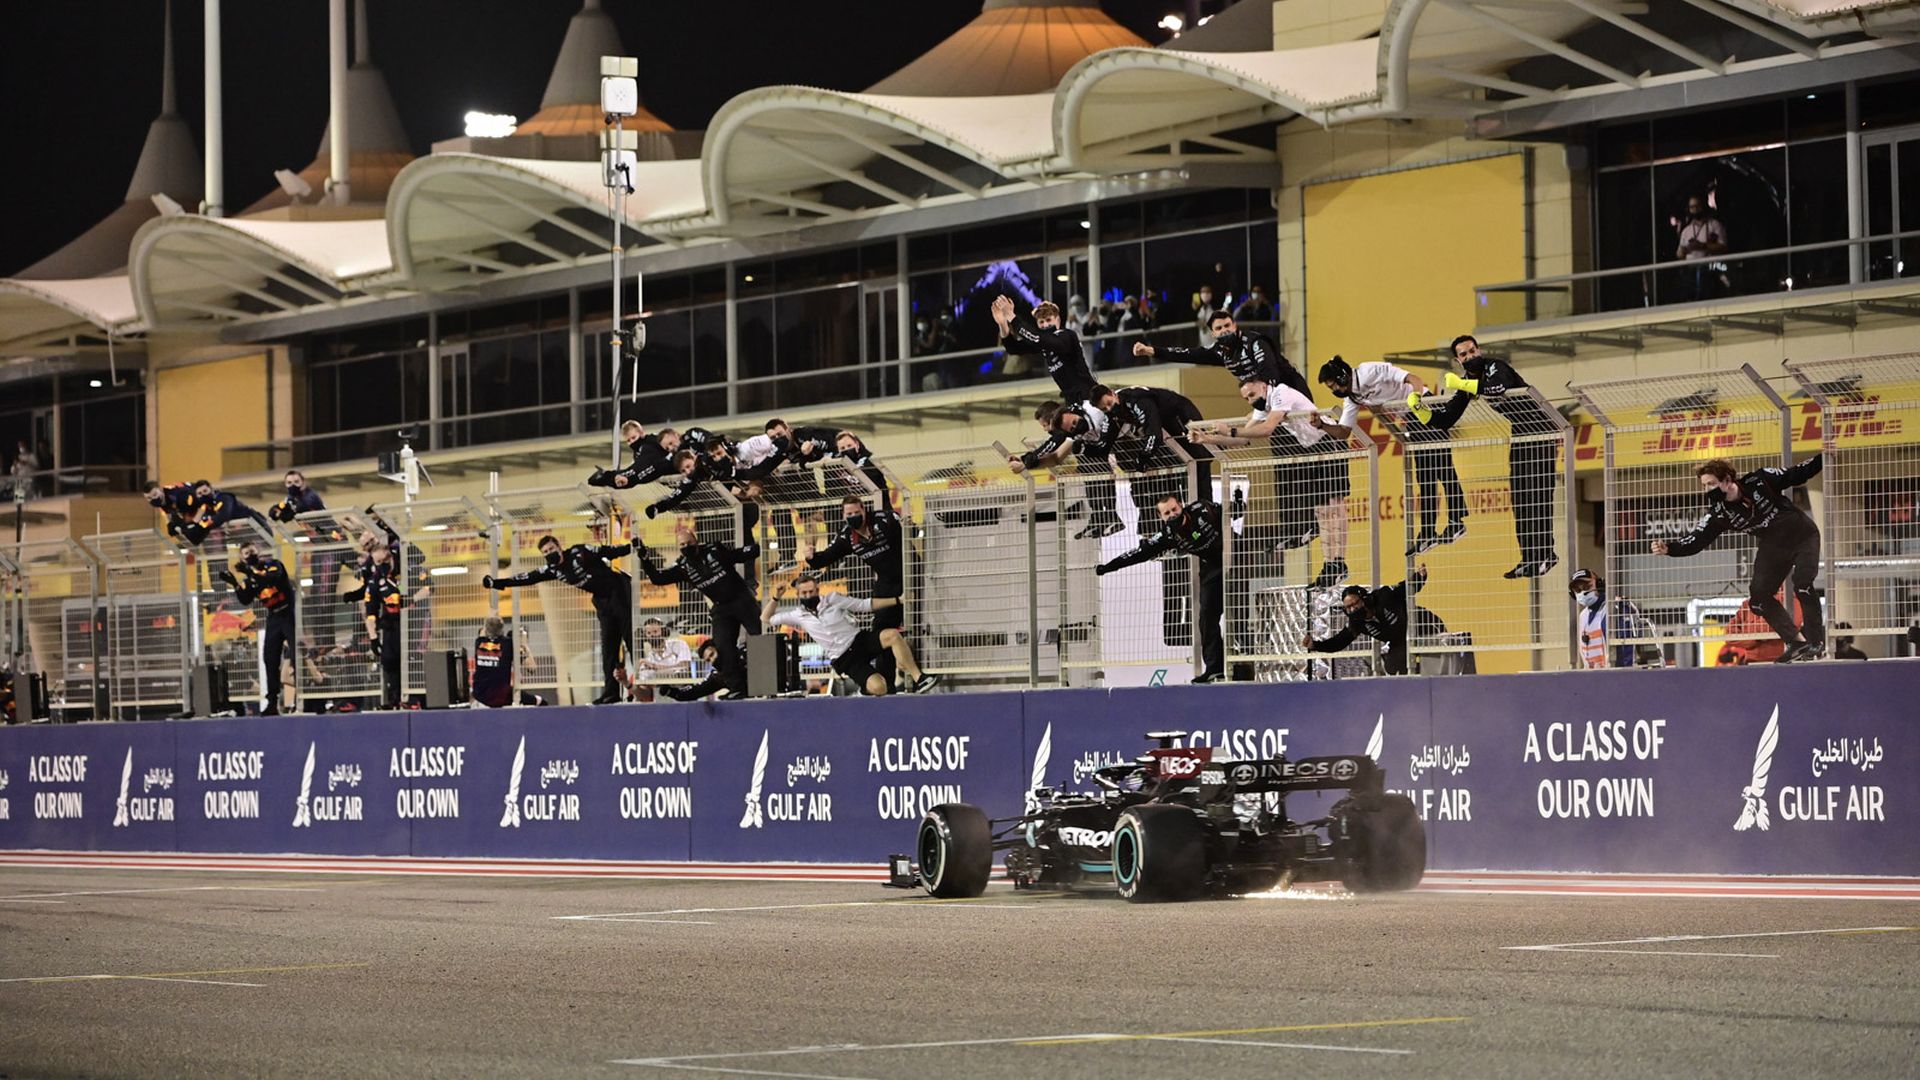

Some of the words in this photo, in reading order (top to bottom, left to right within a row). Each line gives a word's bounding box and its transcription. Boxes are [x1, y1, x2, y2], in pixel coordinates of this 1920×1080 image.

[868, 736, 881, 772] A
[884, 736, 942, 772] CLASS
[945, 736, 971, 772] OF
[1523, 720, 1541, 763] A
[1546, 720, 1627, 763] CLASS
[1632, 720, 1668, 763] OF
[29, 756, 37, 782] A
[38, 756, 71, 782] CLASS
[72, 756, 88, 782] OF
[197, 751, 207, 781] A
[208, 751, 246, 781] CLASS
[247, 751, 265, 781] OF
[389, 746, 400, 778] A
[401, 746, 445, 778] CLASS
[446, 746, 466, 778] OF
[611, 741, 623, 775] A
[624, 741, 675, 775] CLASS
[677, 741, 699, 775] OF
[1160, 756, 1202, 775] INEOS
[1261, 761, 1330, 778] INEOS
[0, 798, 10, 820] IR
[34, 792, 57, 818] OUR
[57, 792, 83, 818] OWN
[130, 798, 157, 820] GULF
[157, 798, 174, 820] AIR
[204, 791, 230, 818] OUR
[230, 791, 259, 818] OWN
[313, 796, 343, 821] GULF
[343, 796, 363, 821] AIR
[396, 788, 426, 818] OUR
[426, 788, 459, 818] OWN
[523, 794, 557, 821] GULF
[558, 794, 581, 821] AIR
[619, 787, 653, 819] OUR
[654, 787, 692, 819] OWN
[767, 793, 806, 821] GULF
[807, 793, 832, 821] AIR
[877, 785, 916, 819] OUR
[918, 785, 962, 817] OWN
[1438, 788, 1472, 821] AIR
[1537, 778, 1591, 818] OUR
[1595, 778, 1655, 818] OWN
[1778, 785, 1841, 821] GULF
[1845, 785, 1885, 821] AIR
